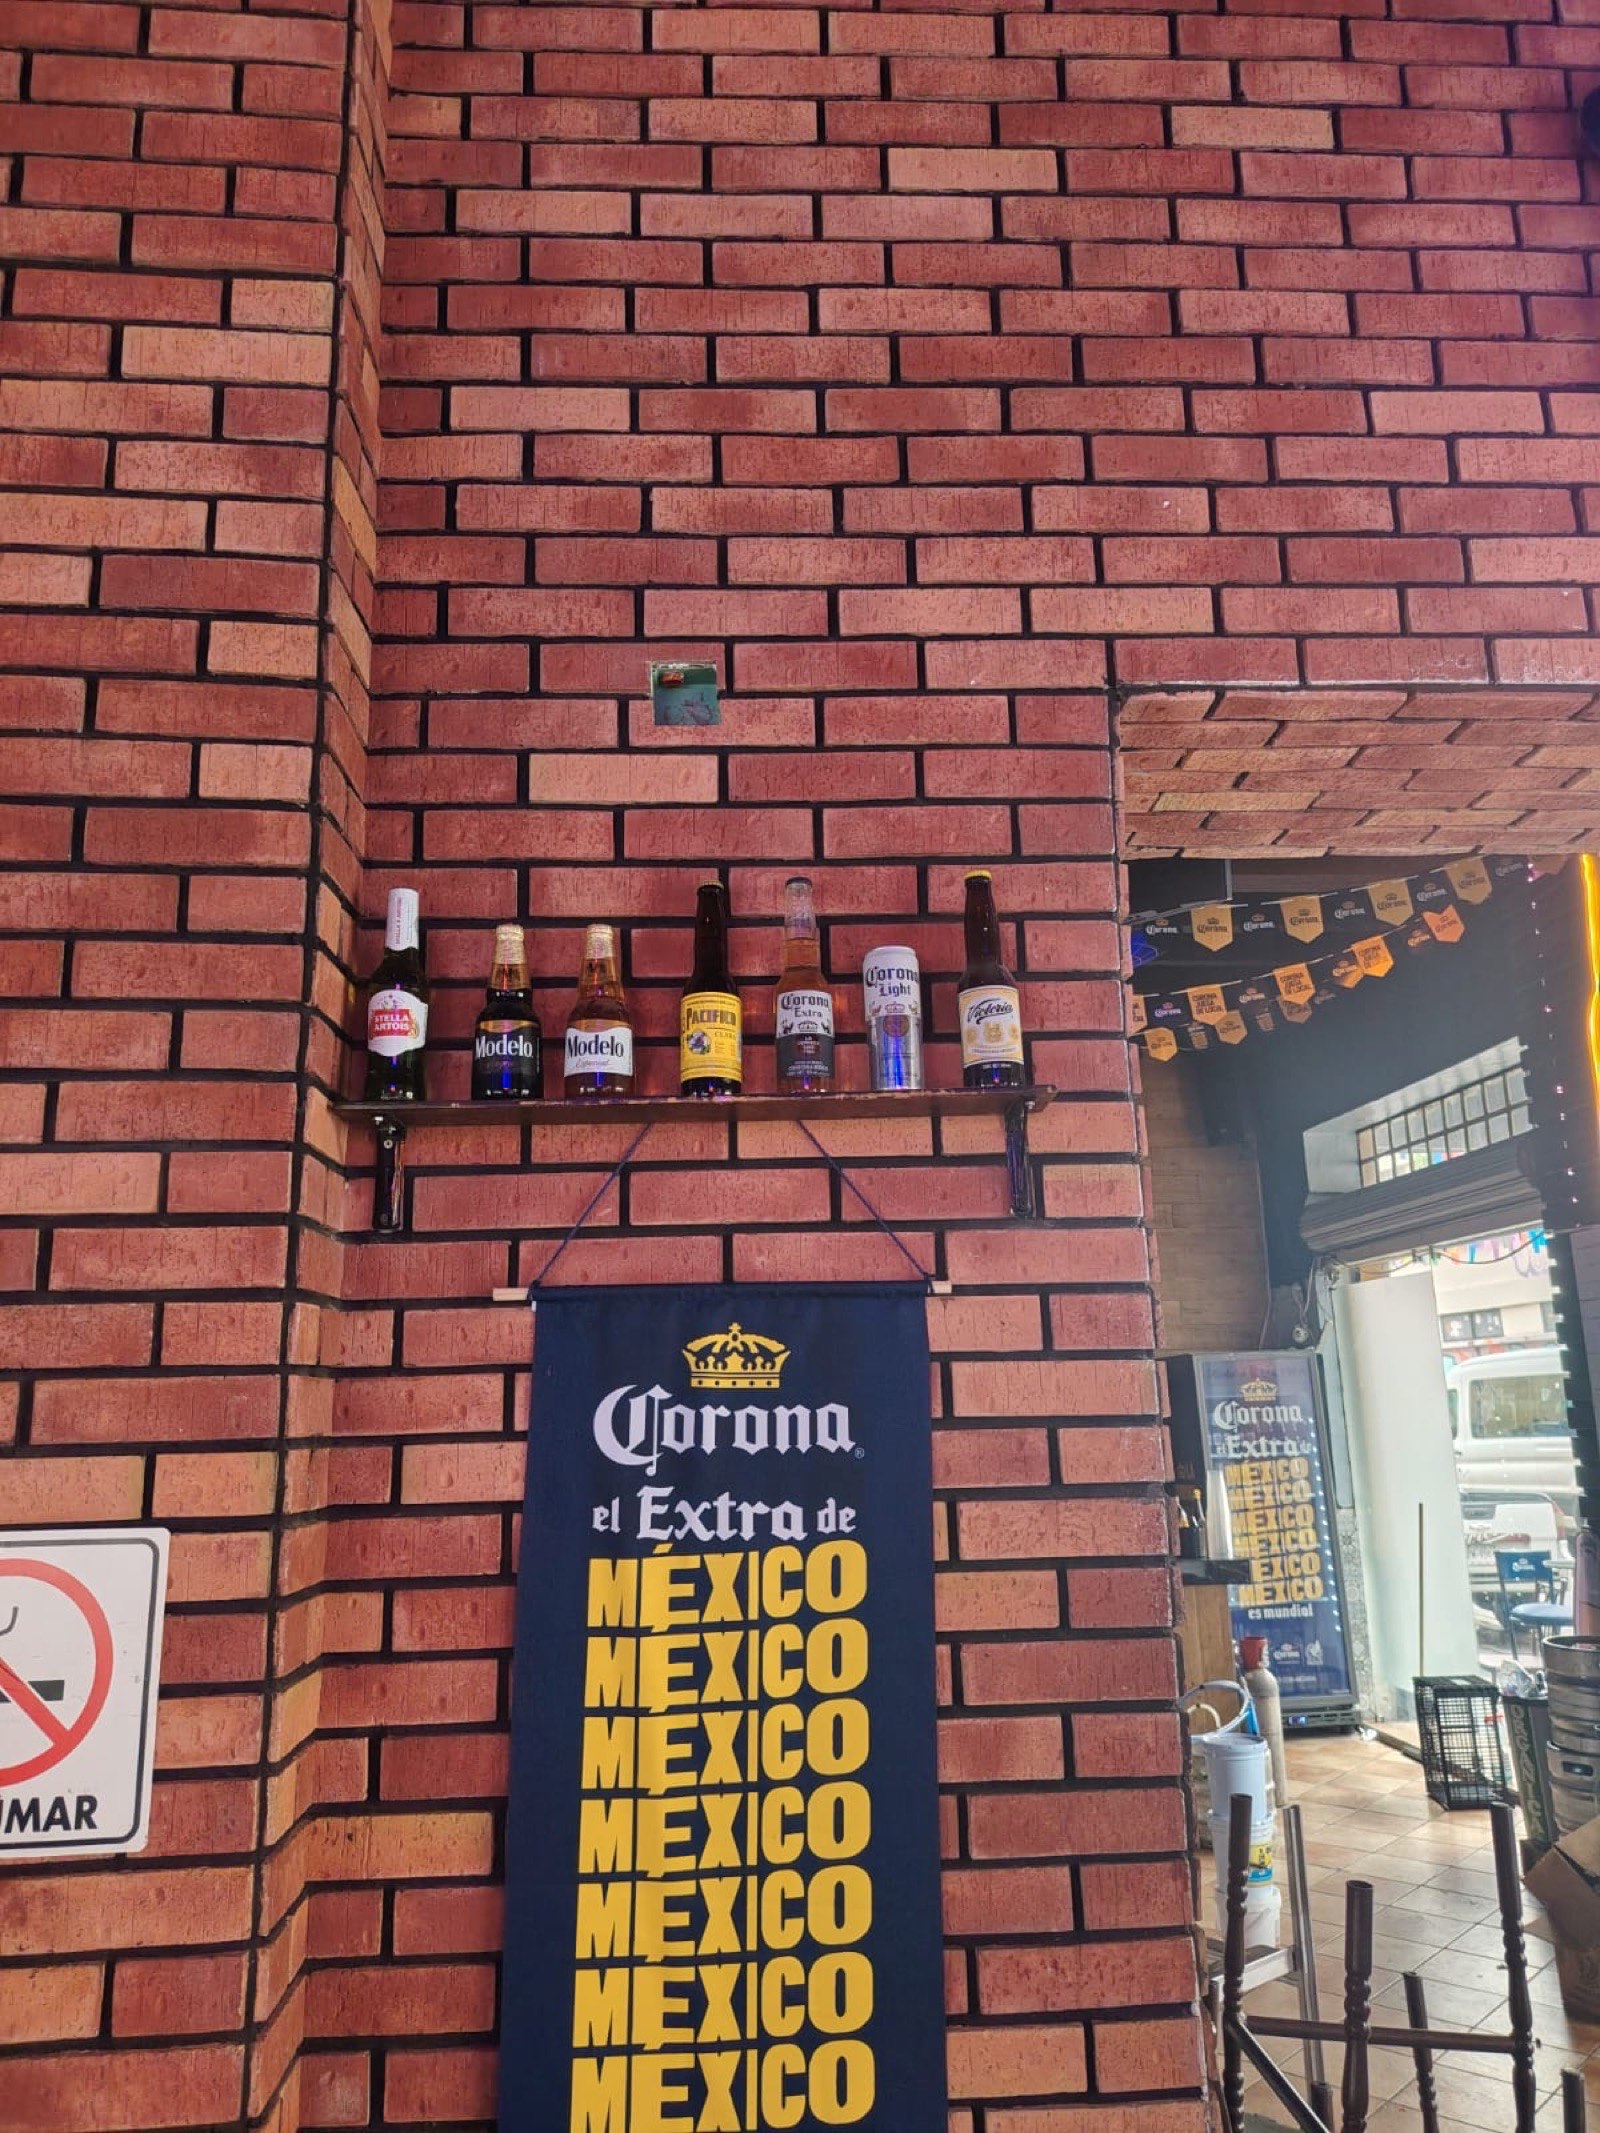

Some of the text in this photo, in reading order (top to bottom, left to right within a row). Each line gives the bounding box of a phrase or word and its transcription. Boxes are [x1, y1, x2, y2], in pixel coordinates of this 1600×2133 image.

[781, 993, 829, 1010] Corona
[879, 983, 911, 997] Light
[373, 1013, 410, 1023] STELLA
[794, 1008, 822, 1018] Extra
[967, 998, 1013, 1024] Victoria
[373, 1023, 410, 1031] ARTOIS
[475, 1034, 533, 1058] Modelo
[567, 1034, 624, 1058] Modelo
[1214, 1401, 1304, 1433] Corona
[593, 1384, 857, 1477] Corona
[1225, 1434, 1301, 1459] Extra
[592, 1485, 857, 1541] el Extra de
[587, 1540, 868, 1628] MÉXICO
[1263, 1602, 1314, 1618] mundial
[0, 1795, 97, 1833] MAR
